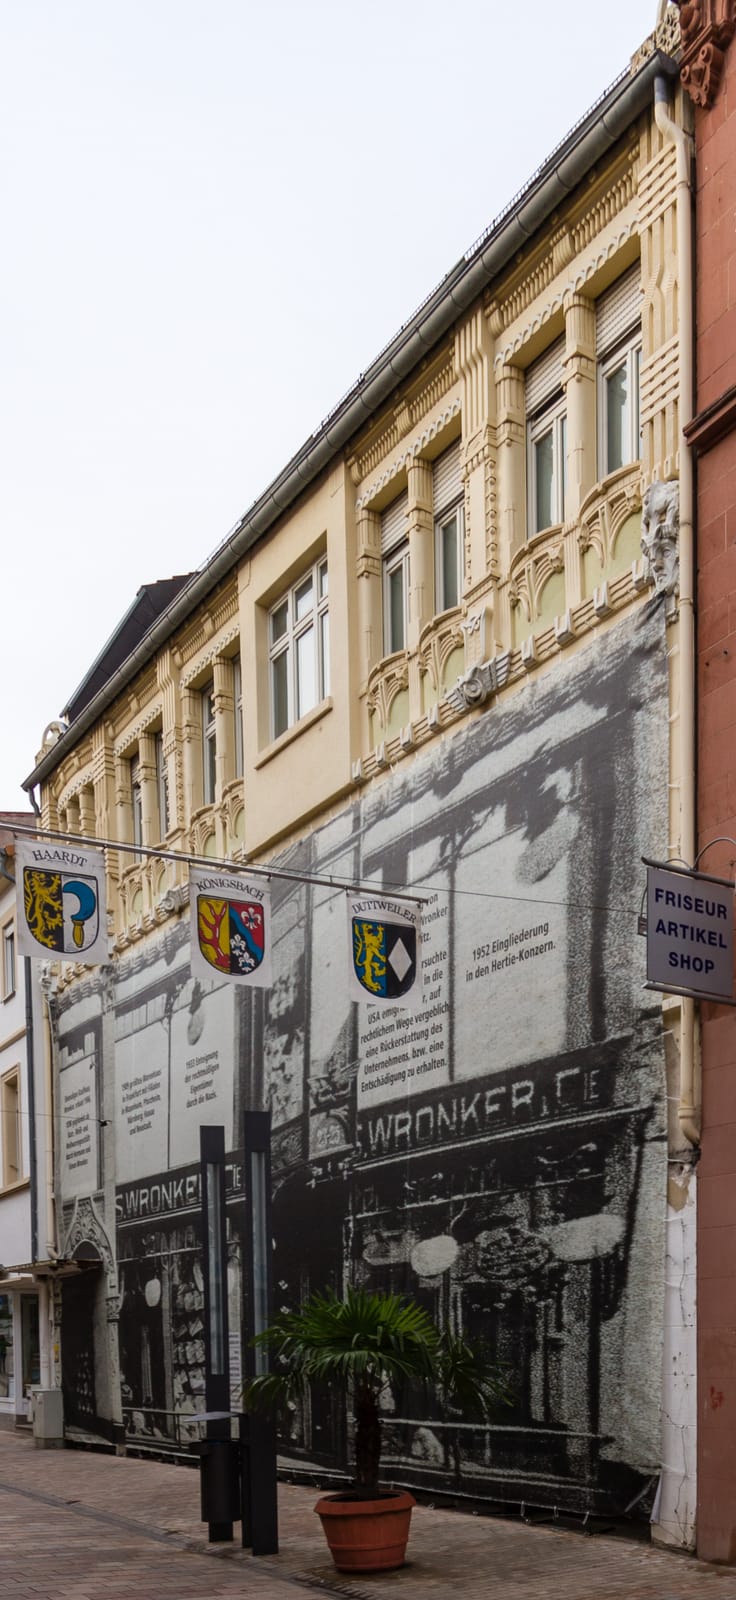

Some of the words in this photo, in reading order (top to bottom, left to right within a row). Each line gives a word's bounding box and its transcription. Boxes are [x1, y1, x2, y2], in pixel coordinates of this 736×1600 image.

[32, 849, 88, 867] HAARDT
[197, 877, 265, 901] KÖNIGSBACH
[655, 888, 727, 920] FRISEUR
[352, 900, 417, 923] DUTTWEILER
[472, 943, 490, 961] 1952
[491, 922, 549, 954] Eingliederung
[655, 918, 728, 949] ARTIKEL
[421, 951, 447, 969] rsuchte
[432, 968, 443, 982] die
[465, 969, 473, 982] in
[474, 965, 490, 979] den
[491, 940, 556, 973] Hertie-Konzern.
[668, 951, 714, 974] SHOP
[367, 1010, 380, 1025] USA
[429, 985, 441, 1001] auf
[360, 1024, 395, 1044] rechtlichem
[396, 1017, 413, 1030] Wege
[415, 1001, 449, 1023] vergeblich
[365, 1046, 379, 1058] eine
[380, 1028, 429, 1053] Rückerstattung
[430, 1023, 443, 1035] des
[411, 1047, 428, 1059] bzw.
[429, 1040, 444, 1053] eine
[361, 1070, 406, 1093] Entschädigung
[407, 1067, 415, 1077] zu
[416, 1058, 447, 1075] erhalten.
